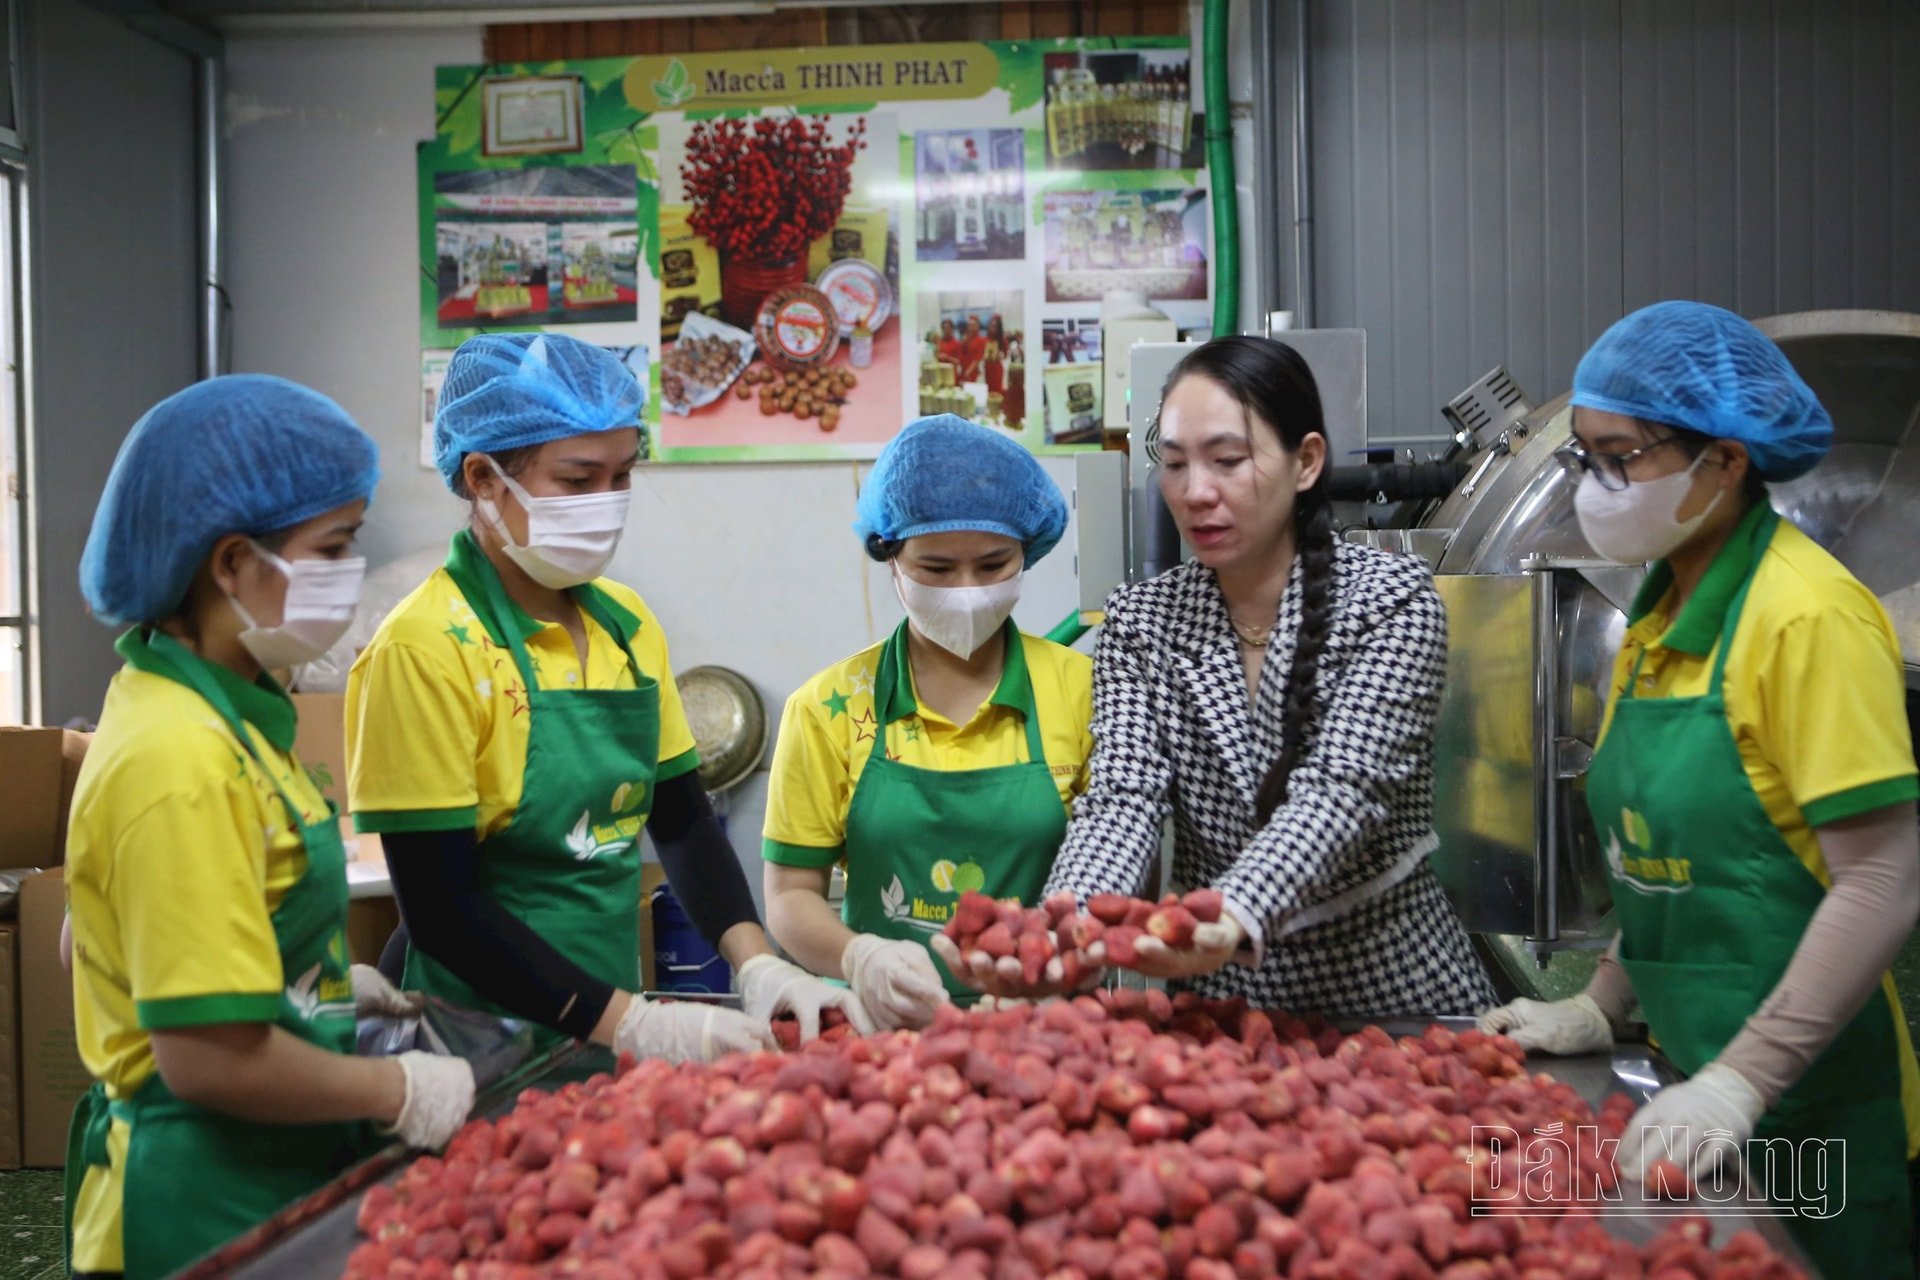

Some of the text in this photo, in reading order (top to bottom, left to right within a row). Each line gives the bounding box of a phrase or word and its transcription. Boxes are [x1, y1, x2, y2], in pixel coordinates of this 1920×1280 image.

[796, 62, 884, 90] THINH
[894, 59, 969, 86] PHAT
[912, 897, 948, 920] Macca
